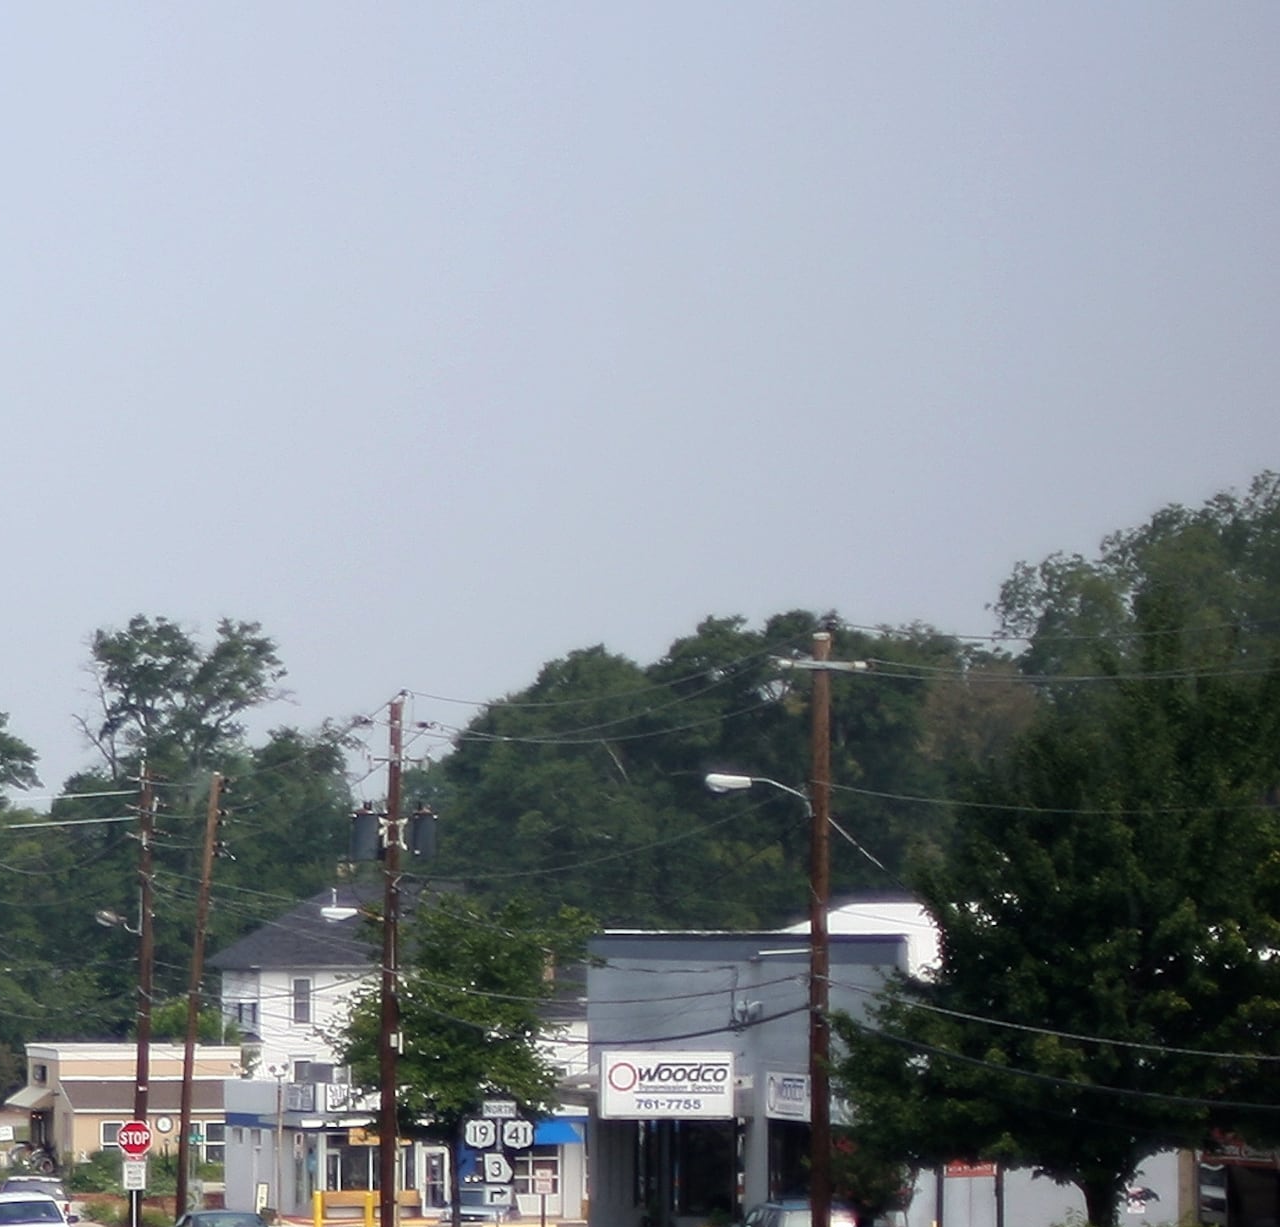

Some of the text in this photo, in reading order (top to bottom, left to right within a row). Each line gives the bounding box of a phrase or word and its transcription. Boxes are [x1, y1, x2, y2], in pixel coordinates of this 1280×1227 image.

[484, 1105, 515, 1115] NORTH
[635, 1099, 702, 1110] 761-7755
[119, 1130, 150, 1145] STOP
[473, 1125, 489, 1143] 19
[507, 1126, 528, 1144] 41
[490, 1161, 502, 1177] 3
